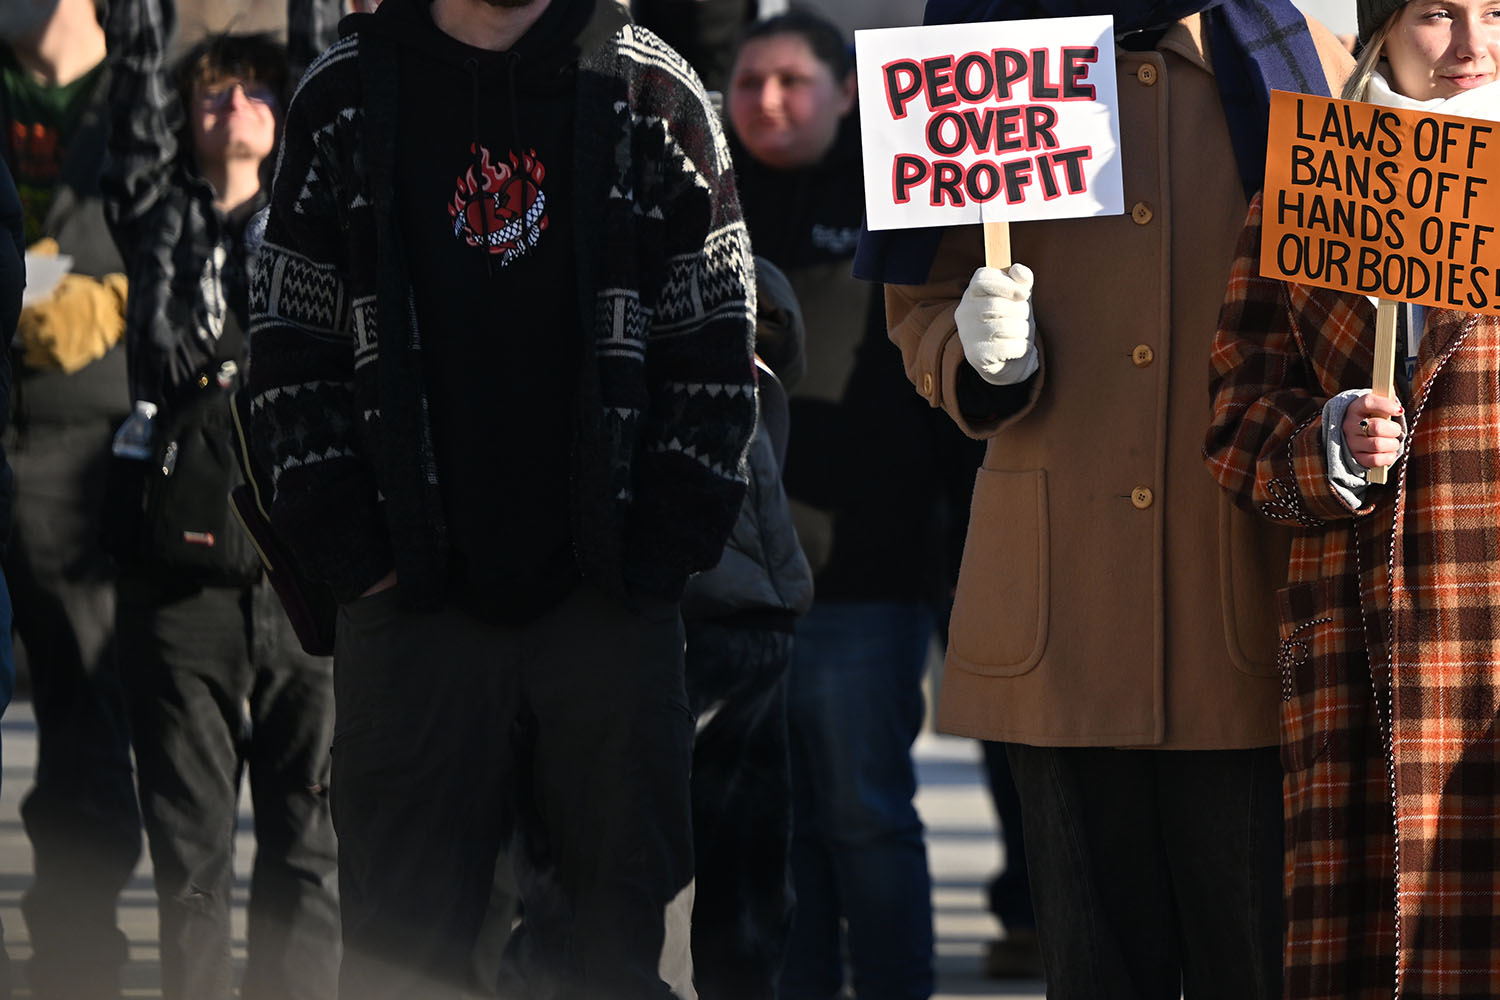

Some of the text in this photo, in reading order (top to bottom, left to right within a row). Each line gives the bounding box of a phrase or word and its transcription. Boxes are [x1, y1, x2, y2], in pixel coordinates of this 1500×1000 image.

[882, 45, 1099, 119] PEOPLE
[925, 104, 1059, 156] OVER
[1296, 98, 1493, 170] LAWS OFF
[891, 145, 1092, 207] PROFIT
[1290, 145, 1488, 219] BANS OFF
[1276, 232, 1352, 285] OUR
[1277, 189, 1496, 265] HANDS OFF
